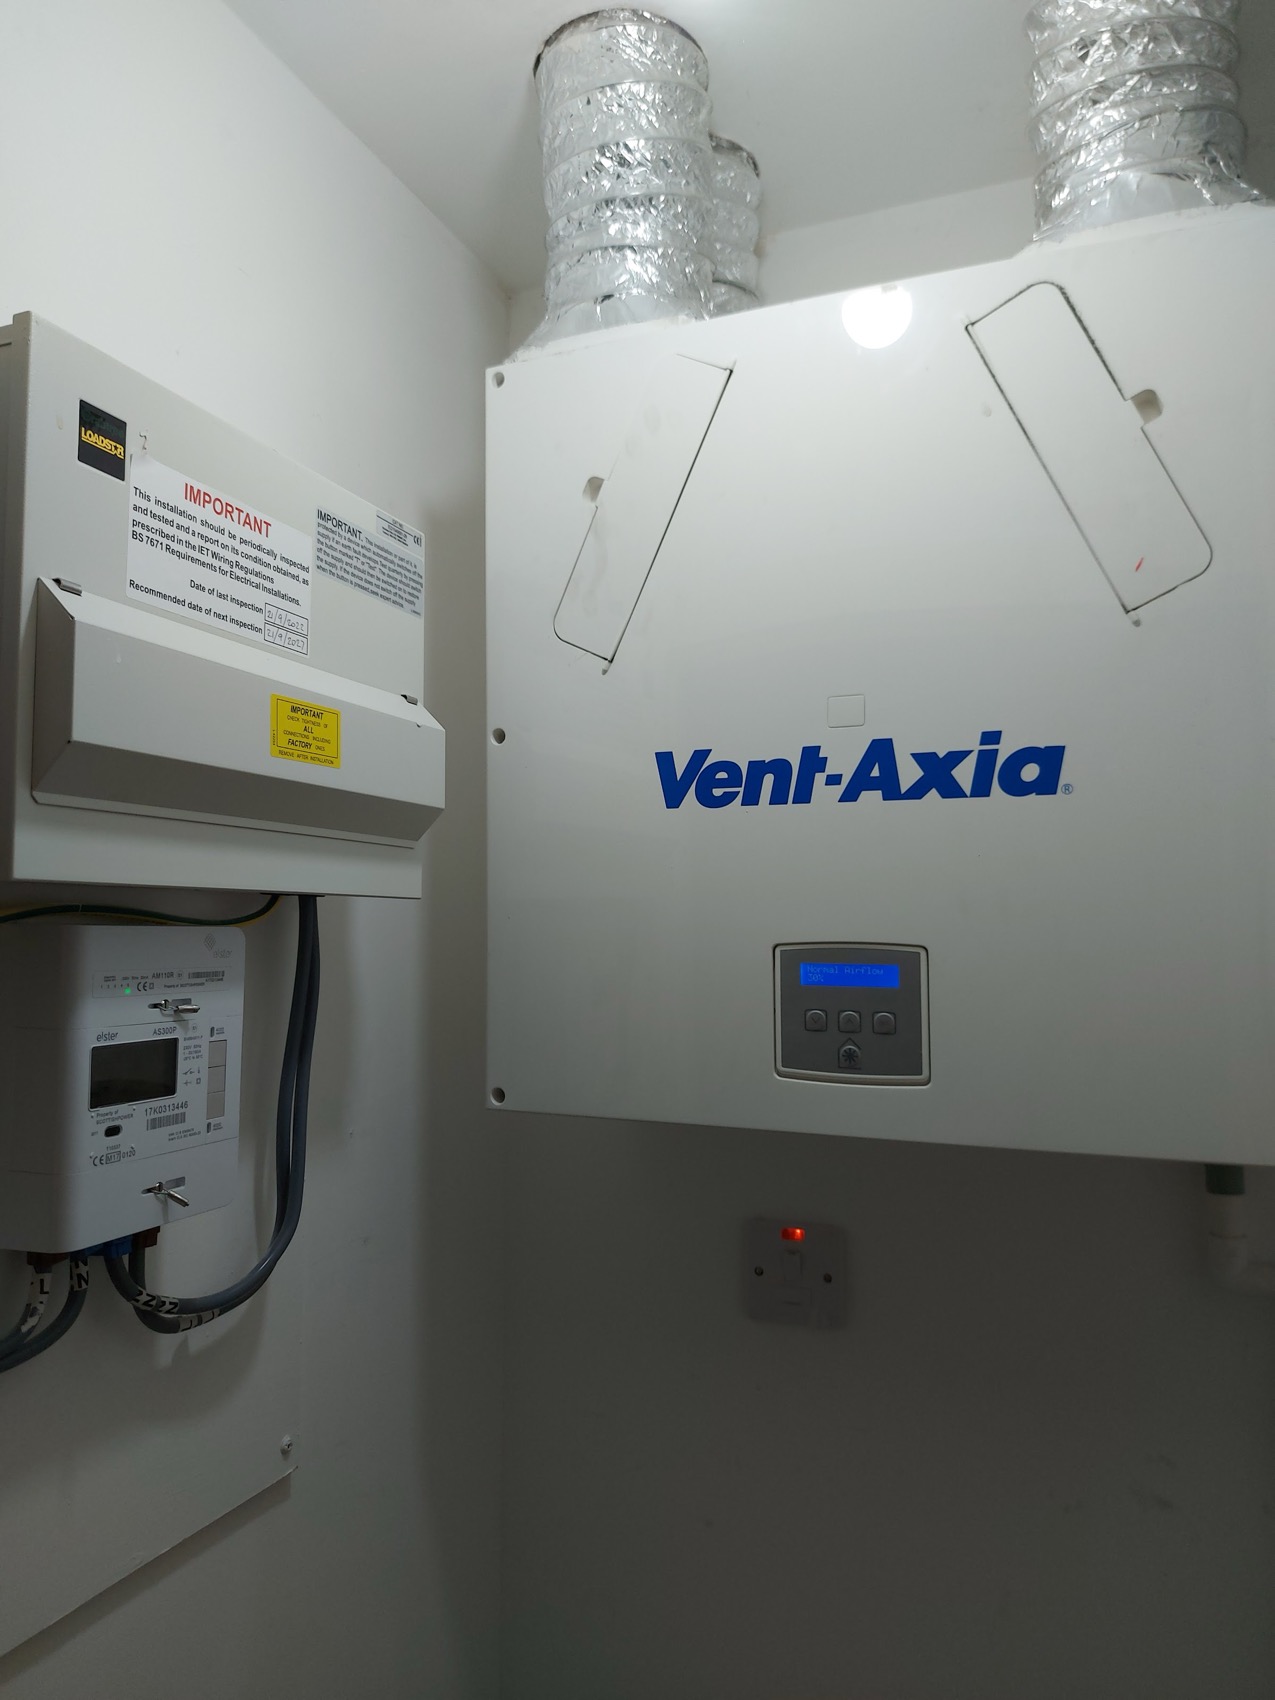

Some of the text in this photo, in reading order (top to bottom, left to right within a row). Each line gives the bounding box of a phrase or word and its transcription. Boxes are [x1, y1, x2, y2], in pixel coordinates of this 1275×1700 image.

[184, 482, 272, 538] IMPORTANT
[133, 486, 310, 575] This installation should be periodically inspected
[132, 503, 149, 517] and
[149, 509, 174, 528] tested
[176, 521, 192, 535] and
[197, 533, 220, 549] report
[220, 543, 230, 552] on
[230, 546, 240, 556] its
[240, 551, 272, 571] condition
[272, 565, 301, 585] obtained,
[302, 579, 310, 587] as
[132, 517, 275, 585] prescribed in the IET Wiring Regulations
[132, 530, 302, 607] BS 7671 Requirements for Electrical Installations.
[189, 579, 264, 616] Date of last inspection
[129, 579, 263, 635] Recommended date of next inspection
[290, 705, 324, 720] IMPORTANT
[286, 714, 300, 722] CHECK
[302, 718, 321, 728] TIGHTNESS
[283, 729, 310, 740] CONNECTIONS
[312, 736, 332, 744] INCLUDING
[303, 725, 314, 734] ALL
[287, 738, 313, 750] FACTORY
[278, 749, 295, 758] REMOVE
[309, 755, 334, 765] INSTALLATION
[655, 730, 1066, 809] Vent-Axia
[152, 971, 175, 980] AM110R
[807, 965, 884, 975] Normal Airflow
[807, 973, 825, 982] 30%
[96, 1031, 119, 1042] elster
[152, 1026, 178, 1036] AS300P
[96, 1111, 113, 1119] Property
[144, 1101, 189, 1117] 17K0313446
[39, 1278, 50, 1295] L
